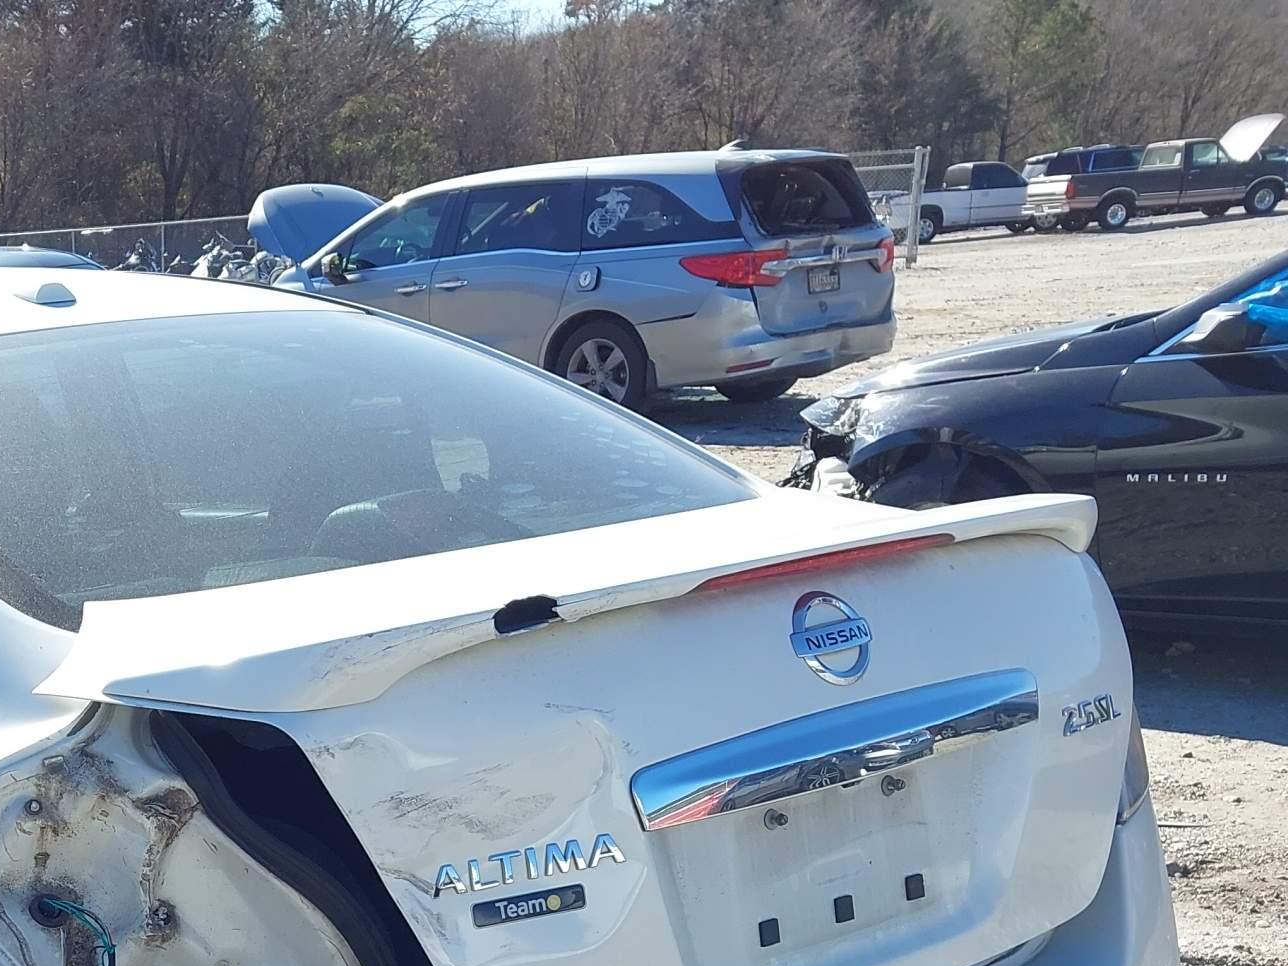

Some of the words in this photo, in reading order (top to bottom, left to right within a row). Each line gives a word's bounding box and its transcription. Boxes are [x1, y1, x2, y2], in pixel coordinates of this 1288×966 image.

[1125, 472, 1228, 483] MALIBU
[804, 622, 869, 651] NISSAN
[431, 832, 627, 899] ALTIMA
